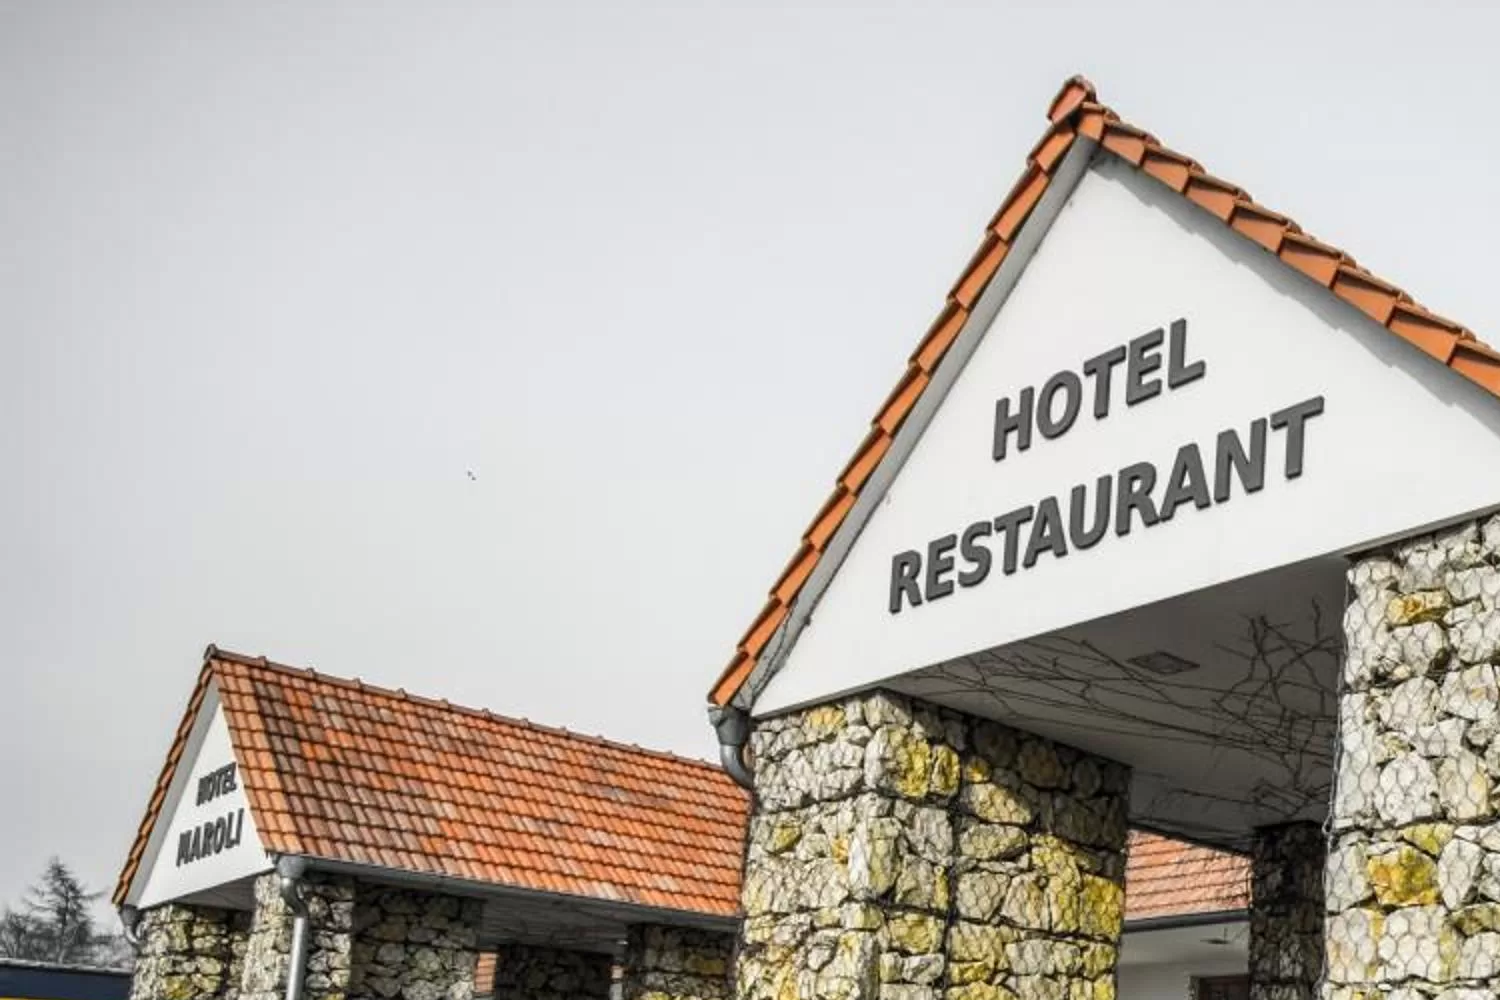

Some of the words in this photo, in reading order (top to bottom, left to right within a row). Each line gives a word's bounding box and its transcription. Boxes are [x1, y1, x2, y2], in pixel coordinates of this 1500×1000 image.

[992, 318, 1206, 462] HOTEL
[888, 396, 1325, 614] RESTAURANT
[196, 761, 237, 807] HOTEL
[176, 808, 245, 867] MAROLI
